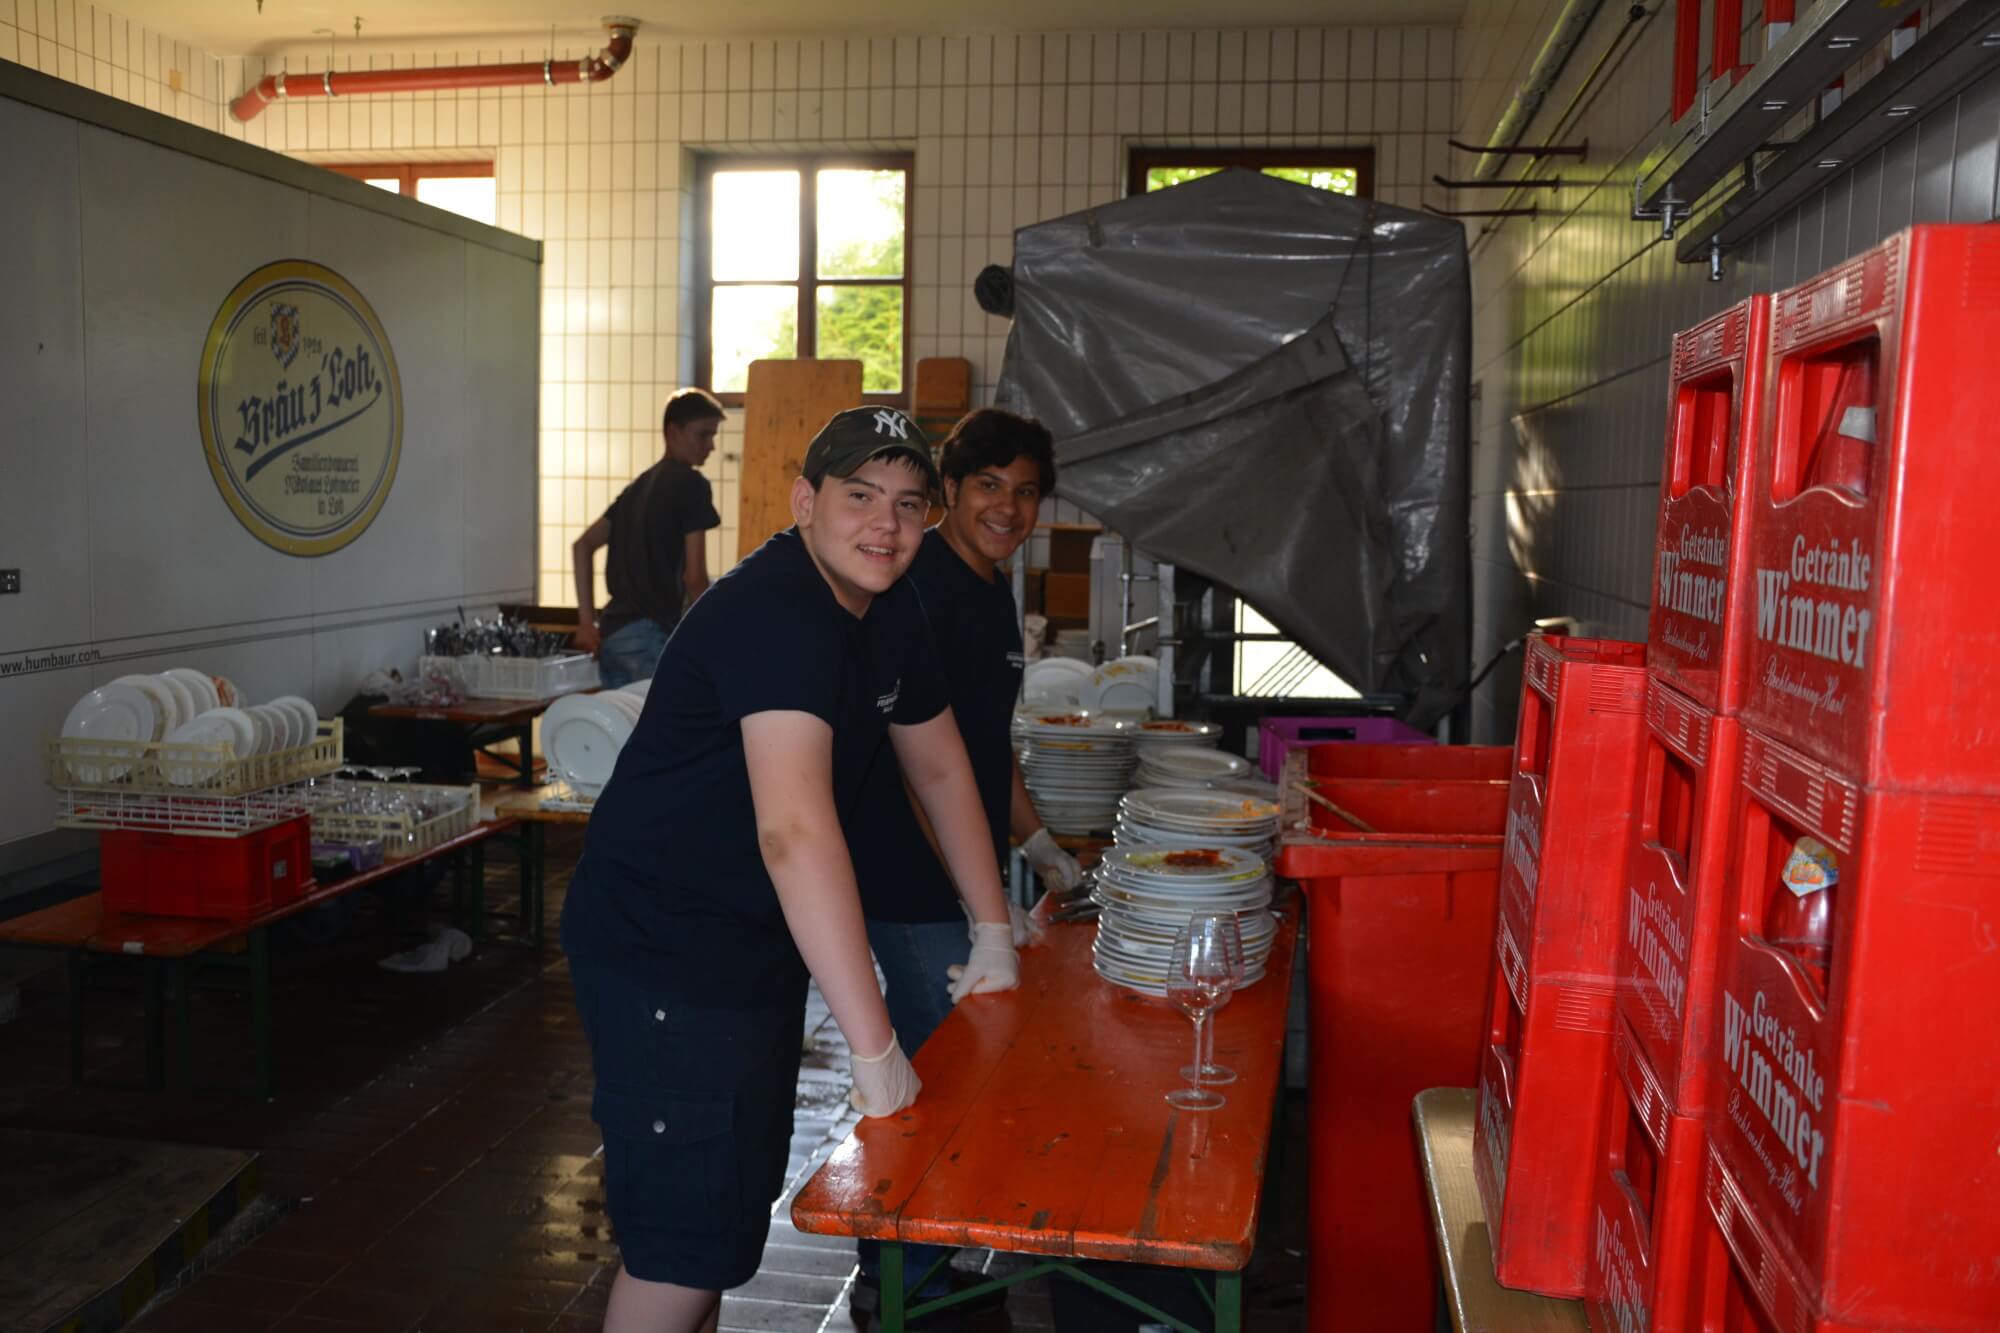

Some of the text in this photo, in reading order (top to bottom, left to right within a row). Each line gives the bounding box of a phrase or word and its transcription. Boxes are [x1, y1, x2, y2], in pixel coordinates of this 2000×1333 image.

[234, 379, 307, 455] Bräu
[873, 410, 908, 439] NY
[1681, 522, 1725, 567] Getränke
[1791, 533, 1872, 592] Getränke
[1659, 551, 1725, 625] Wimmer
[1757, 568, 1872, 669] Wimmer
[0, 650, 99, 674] ww.humbaur.com
[1629, 886, 1685, 1020] Wimmer
[1647, 881, 1686, 962] Getränke
[1753, 990, 1825, 1112] Getränke
[1724, 989, 1825, 1192] Wimmer
[1596, 1204, 1638, 1333] Wimm
